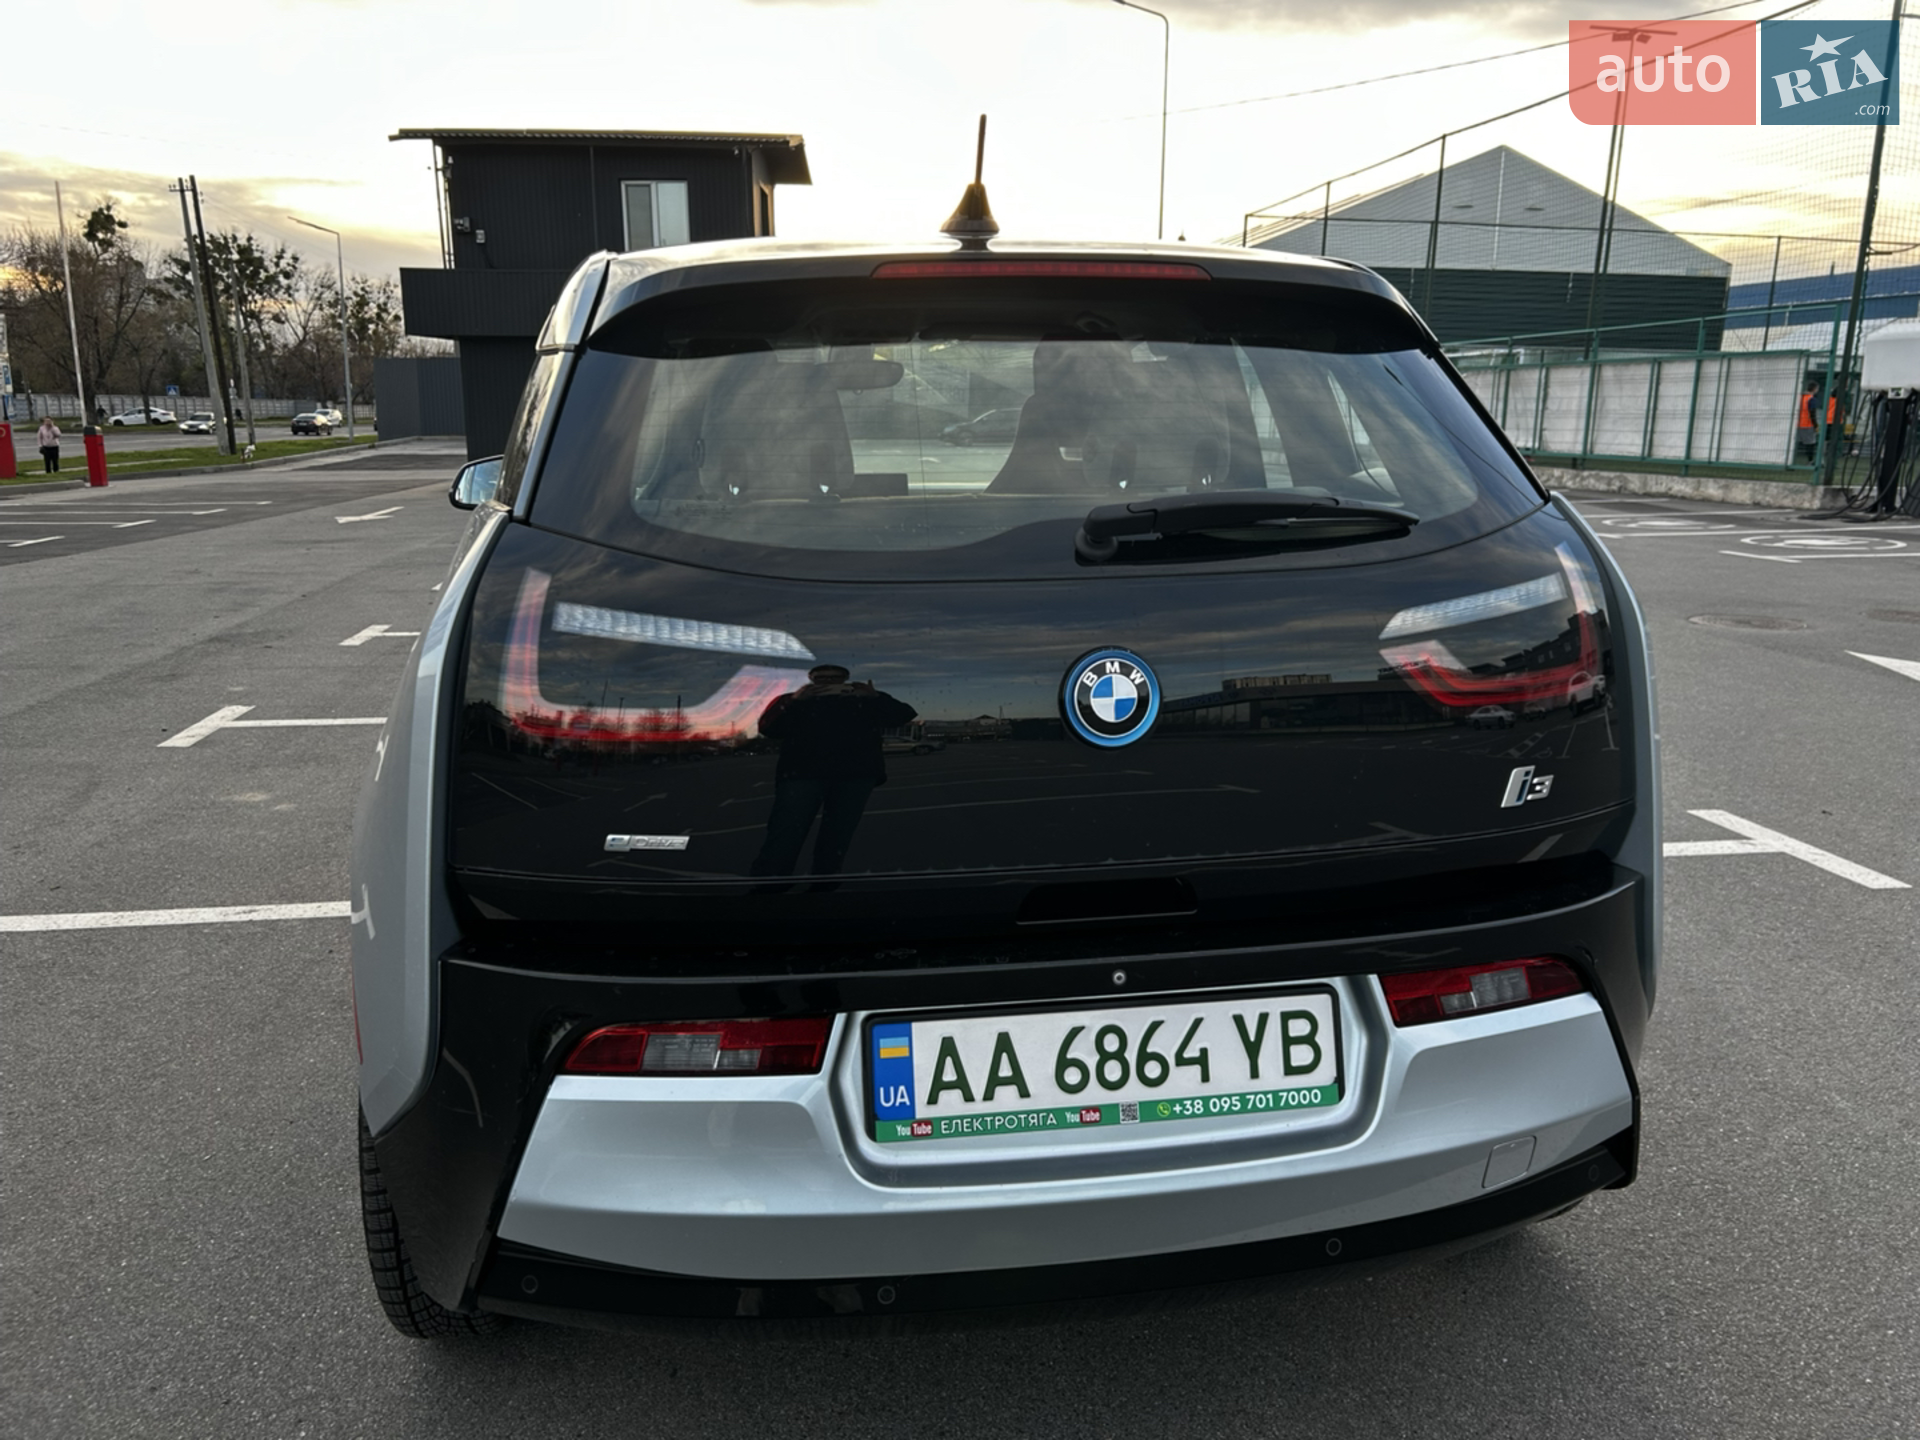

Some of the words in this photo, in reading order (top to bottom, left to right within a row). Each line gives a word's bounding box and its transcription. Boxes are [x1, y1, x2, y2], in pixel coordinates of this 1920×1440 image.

[1082, 660, 1145, 688] BMW
[1501, 765, 1554, 808] i3
[926, 1031, 1032, 1106] AA
[1054, 1017, 1210, 1095] 6864
[1231, 1009, 1322, 1080] YB
[879, 1085, 911, 1107] UA
[896, 1120, 933, 1137] YouTube
[941, 1112, 1057, 1135] ЕЛЕКТРОТЯГА
[1065, 1107, 1101, 1124] YouTube
[1172, 1101, 1204, 1115] +38
[1209, 1096, 1241, 1113] 095
[1246, 1093, 1274, 1110] 701
[1278, 1089, 1321, 1106] 7000
